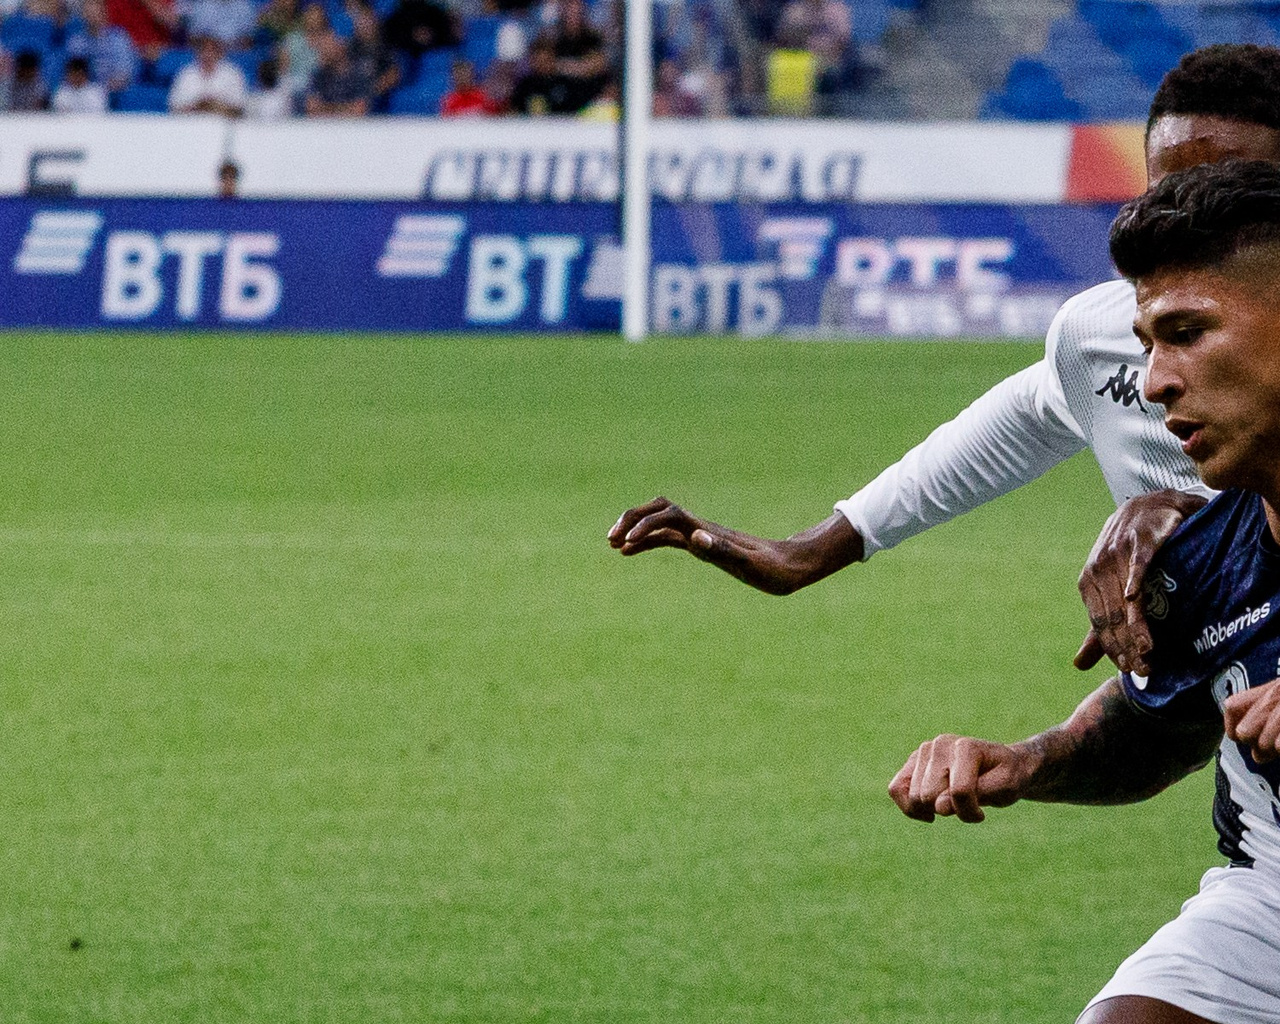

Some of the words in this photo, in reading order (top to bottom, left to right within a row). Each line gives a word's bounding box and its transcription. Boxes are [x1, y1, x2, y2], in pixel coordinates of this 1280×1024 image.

[102, 231, 283, 321] ВТБ
[465, 234, 584, 324] ВТ
[651, 261, 784, 334] ВТБ
[1193, 602, 1271, 654] wildberries
